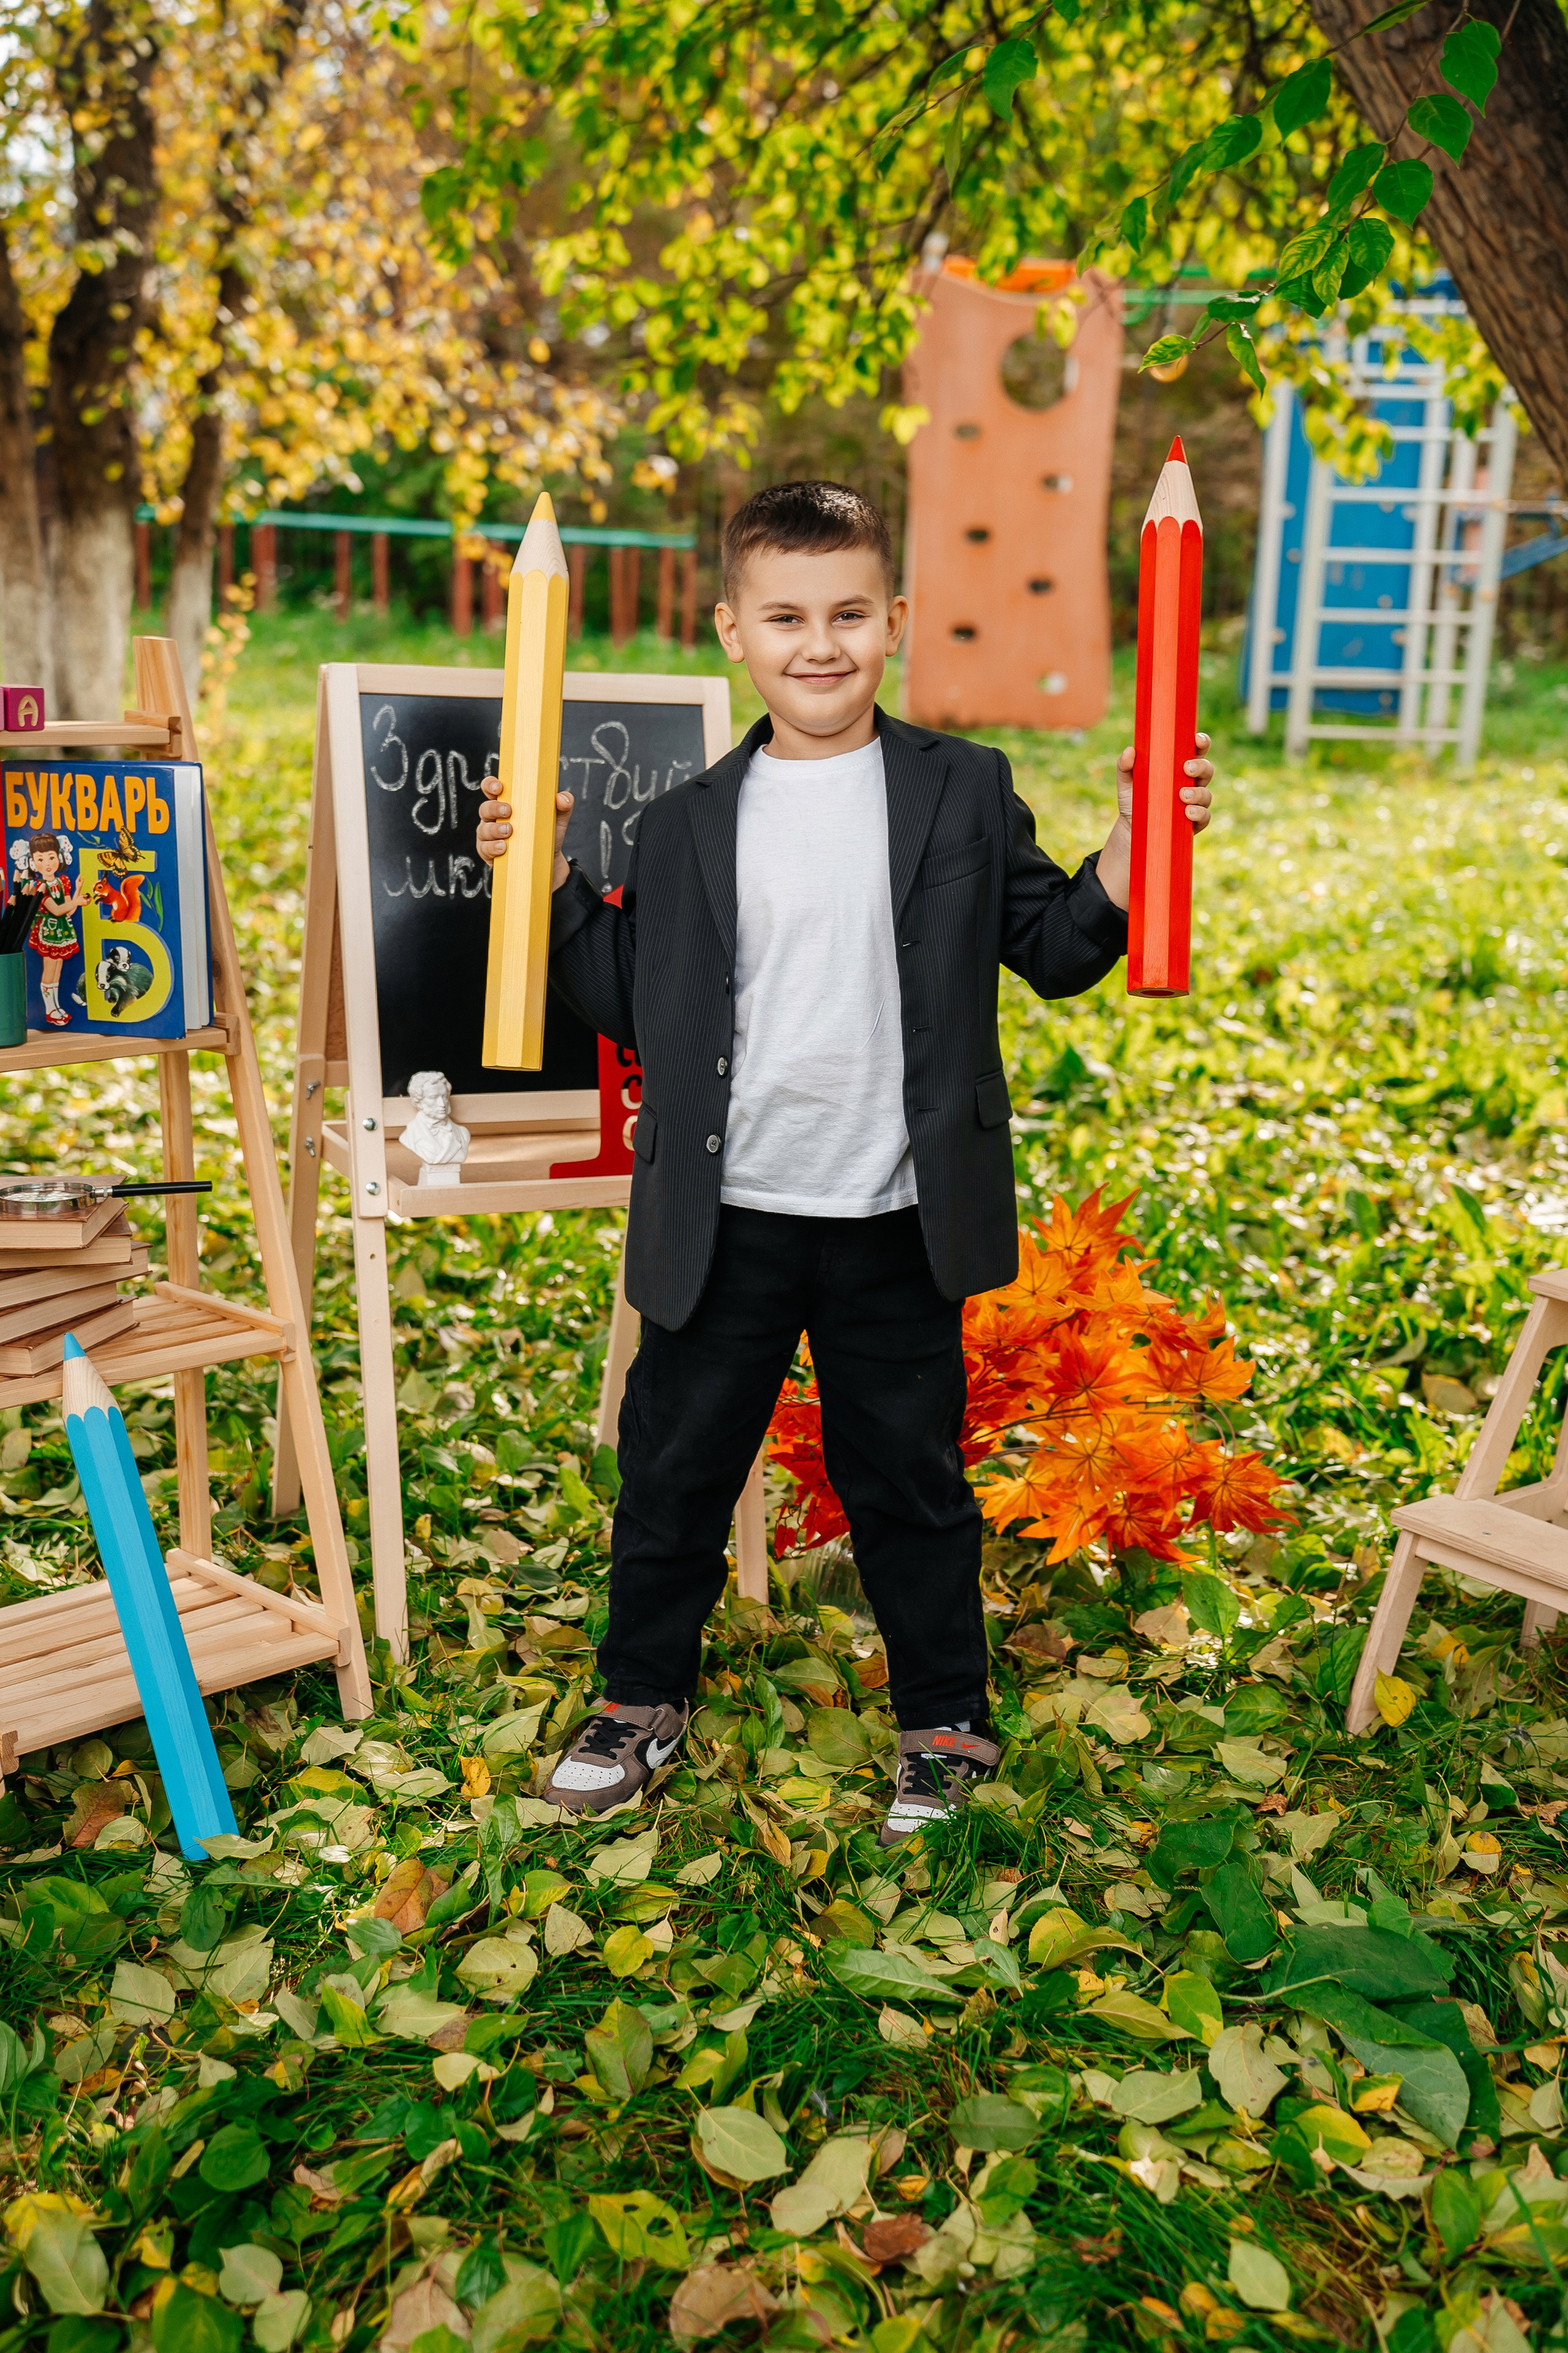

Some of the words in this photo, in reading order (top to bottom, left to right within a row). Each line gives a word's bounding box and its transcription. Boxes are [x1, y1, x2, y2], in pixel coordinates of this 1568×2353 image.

[5, 771, 170, 834] БУКВАРЬ
[79, 848, 174, 1022] Б
[932, 1735, 956, 1747] NIKE
